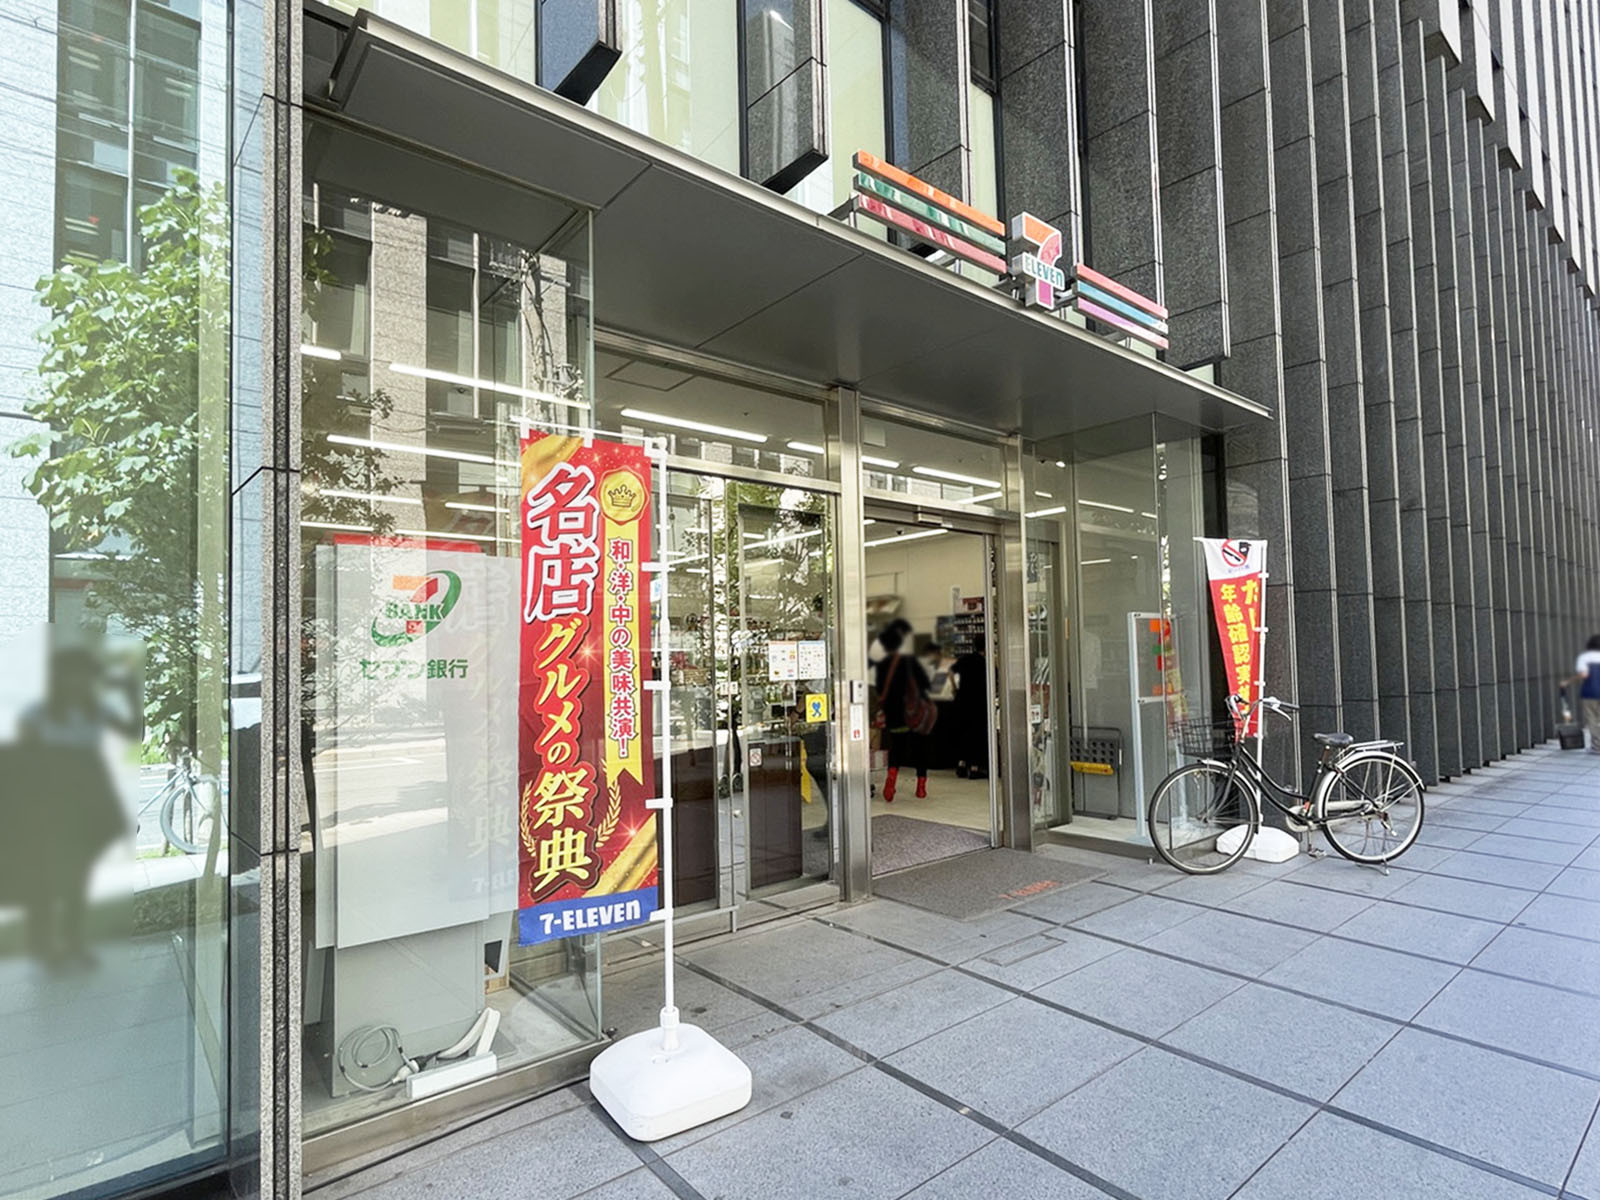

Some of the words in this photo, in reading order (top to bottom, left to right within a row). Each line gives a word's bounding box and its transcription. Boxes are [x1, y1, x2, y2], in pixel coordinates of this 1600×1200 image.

[359, 658, 468, 680] セブン銀行
